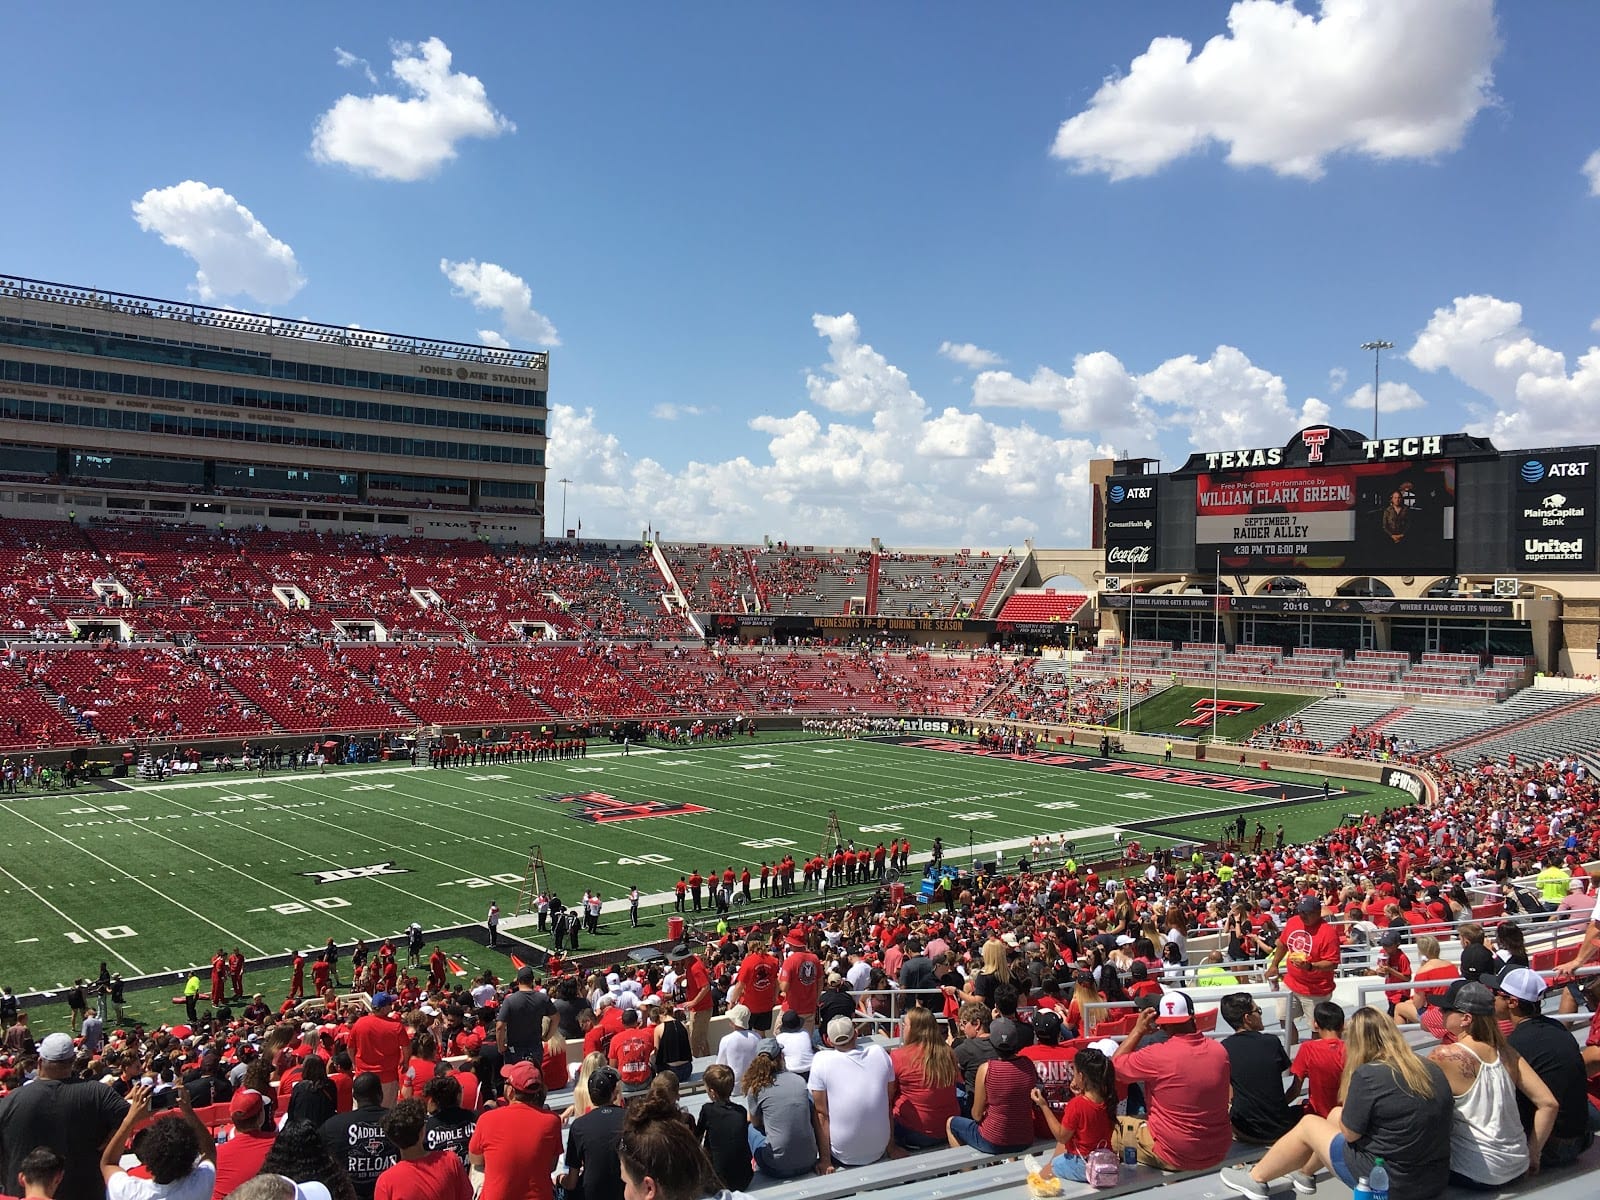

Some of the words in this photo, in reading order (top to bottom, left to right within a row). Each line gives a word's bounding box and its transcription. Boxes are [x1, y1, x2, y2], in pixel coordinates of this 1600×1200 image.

[418, 365, 453, 376] JONES
[492, 373, 537, 385] STADIUM
[1205, 448, 1281, 470] TEXAS
[1362, 436, 1441, 459] TECH
[1548, 462, 1589, 478] AT&T
[1271, 479, 1315, 487] Performance
[1316, 478, 1326, 486] by
[1126, 487, 1152, 499] AT&T
[1200, 490, 1253, 506] WILLIAM
[1257, 488, 1299, 504] CLARK
[1303, 485, 1350, 502] GREEN!
[1524, 507, 1585, 519] PlainsCapital
[1244, 517, 1290, 527] SEPTEMBER
[1292, 516, 1297, 525] 7
[1542, 517, 1565, 526] Bank
[1233, 527, 1270, 539] RAIDER
[1274, 526, 1309, 538] ALLEY
[1233, 546, 1249, 555] 4:30
[1251, 545, 1263, 554] PM
[1265, 545, 1276, 554] TO
[1278, 545, 1293, 554] 6:00
[1295, 544, 1308, 554] PM
[1524, 538, 1583, 553] United
[1108, 546, 1152, 564] Coca-Cola
[1525, 553, 1583, 561] supermarkets
[1497, 580, 1515, 593] 25
[1283, 602, 1309, 611] 20:16
[814, 617, 860, 628] WEDNESDAYS
[863, 618, 886, 629] 7P-8P
[889, 619, 915, 630] DURING
[919, 620, 932, 630] THE
[935, 620, 963, 631] SEASON
[1088, 762, 1282, 792] TECH
[739, 837, 799, 849] 50
[616, 853, 674, 866] 40
[454, 872, 527, 888] 30
[269, 896, 353, 915] 20
[63, 924, 139, 944] 10
[1033, 1060, 1074, 1082] ONES
[348, 1123, 386, 1146] SADDLE
[427, 1128, 463, 1150] SADDLE
